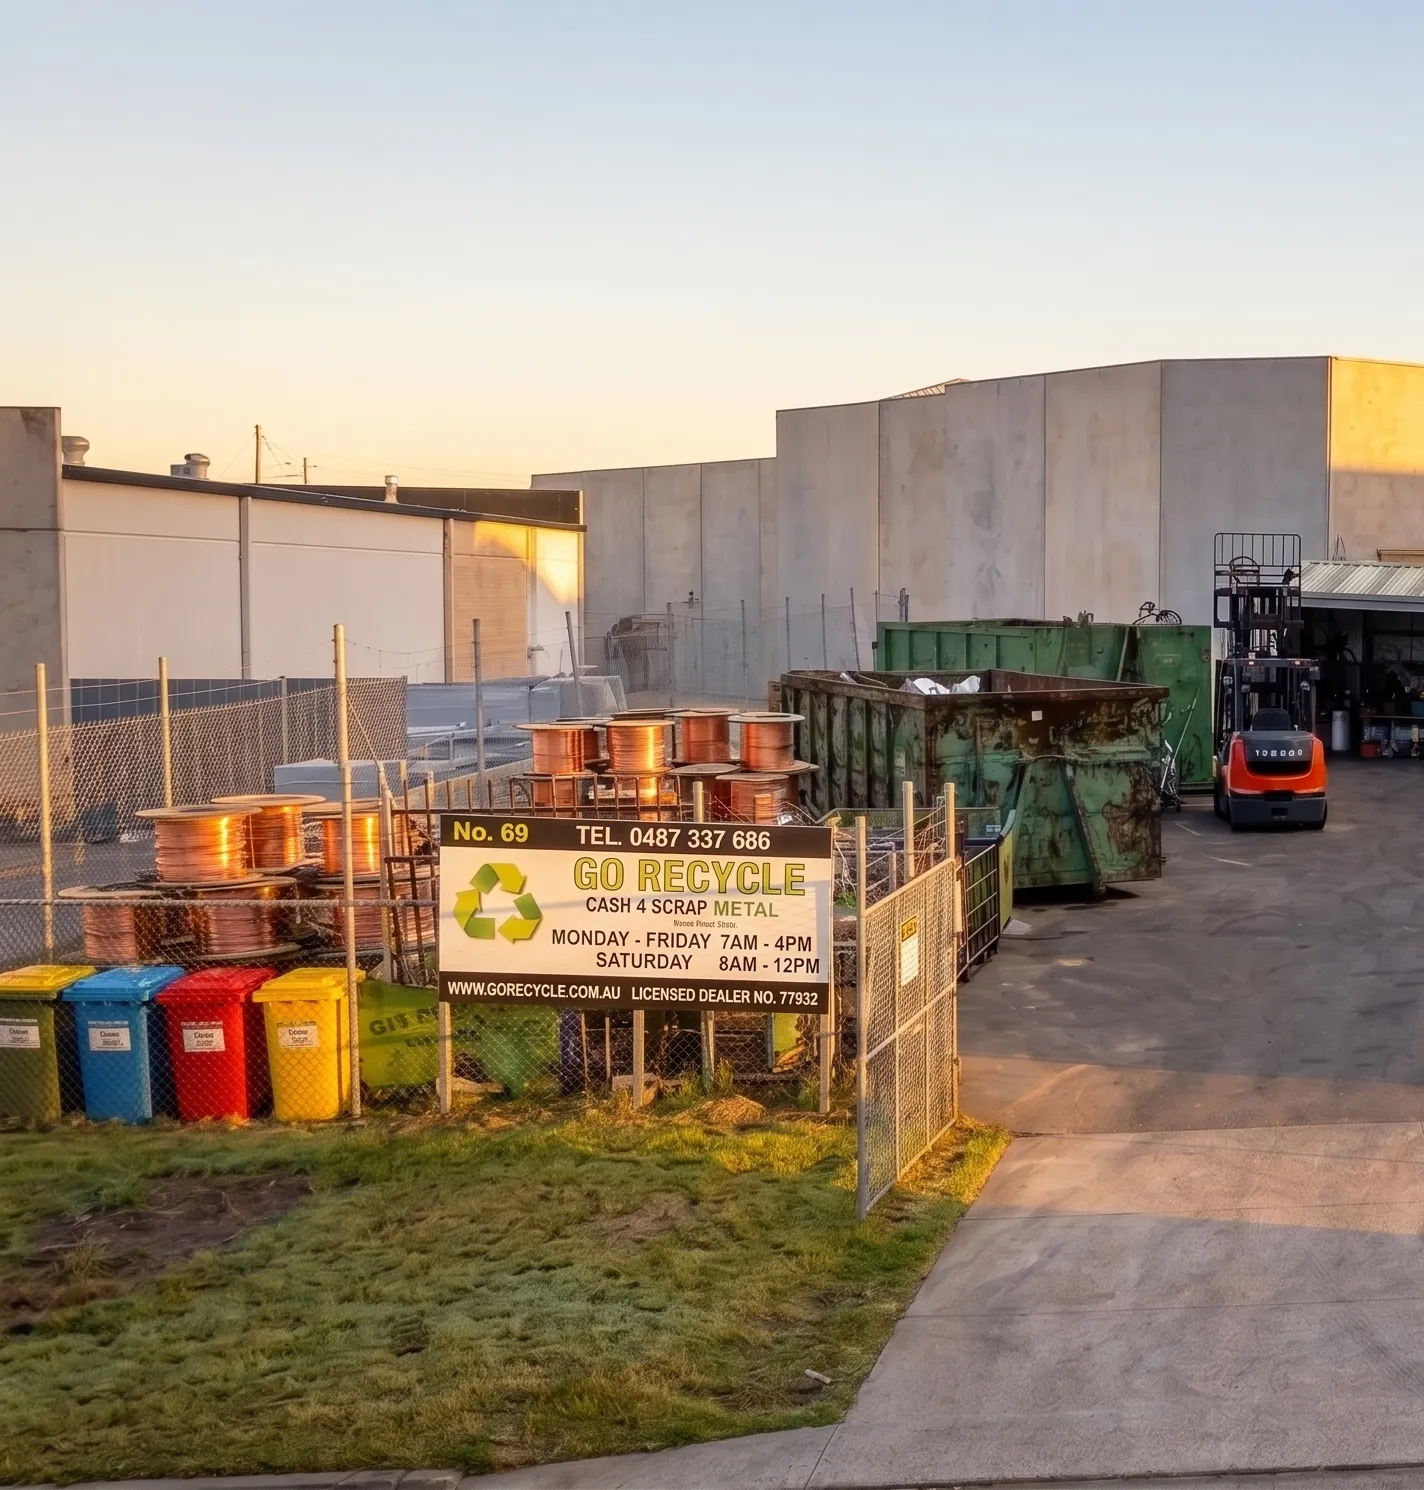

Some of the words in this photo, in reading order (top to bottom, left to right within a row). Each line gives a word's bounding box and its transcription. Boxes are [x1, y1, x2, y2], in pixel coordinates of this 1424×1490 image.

[453, 821, 493, 842] No.
[501, 823, 529, 843] 69
[576, 825, 622, 846] TEL.
[630, 827, 681, 848] 0487
[687, 829, 725, 849] 337
[732, 831, 771, 850] 686
[573, 857, 624, 892] GO
[638, 859, 806, 896] RECYCLE
[585, 897, 631, 914] CASH
[636, 898, 647, 914] 4
[651, 899, 708, 916] SCRAP
[713, 900, 779, 918] METAL
[552, 929, 630, 948] MONDAY
[646, 932, 712, 950] FRIDAY
[720, 934, 759, 951] 7AM
[775, 935, 812, 952] 4PM
[596, 952, 693, 971] SATURDAY
[718, 955, 757, 973] 8AM
[774, 957, 820, 974] 12PM
[447, 981, 621, 1000] WWW.GORECYCLE.COM.AU
[631, 985, 696, 1002] LICENSED
[699, 989, 752, 1004] DEALER
[754, 991, 776, 1005] NO.
[779, 992, 818, 1006] 77932
